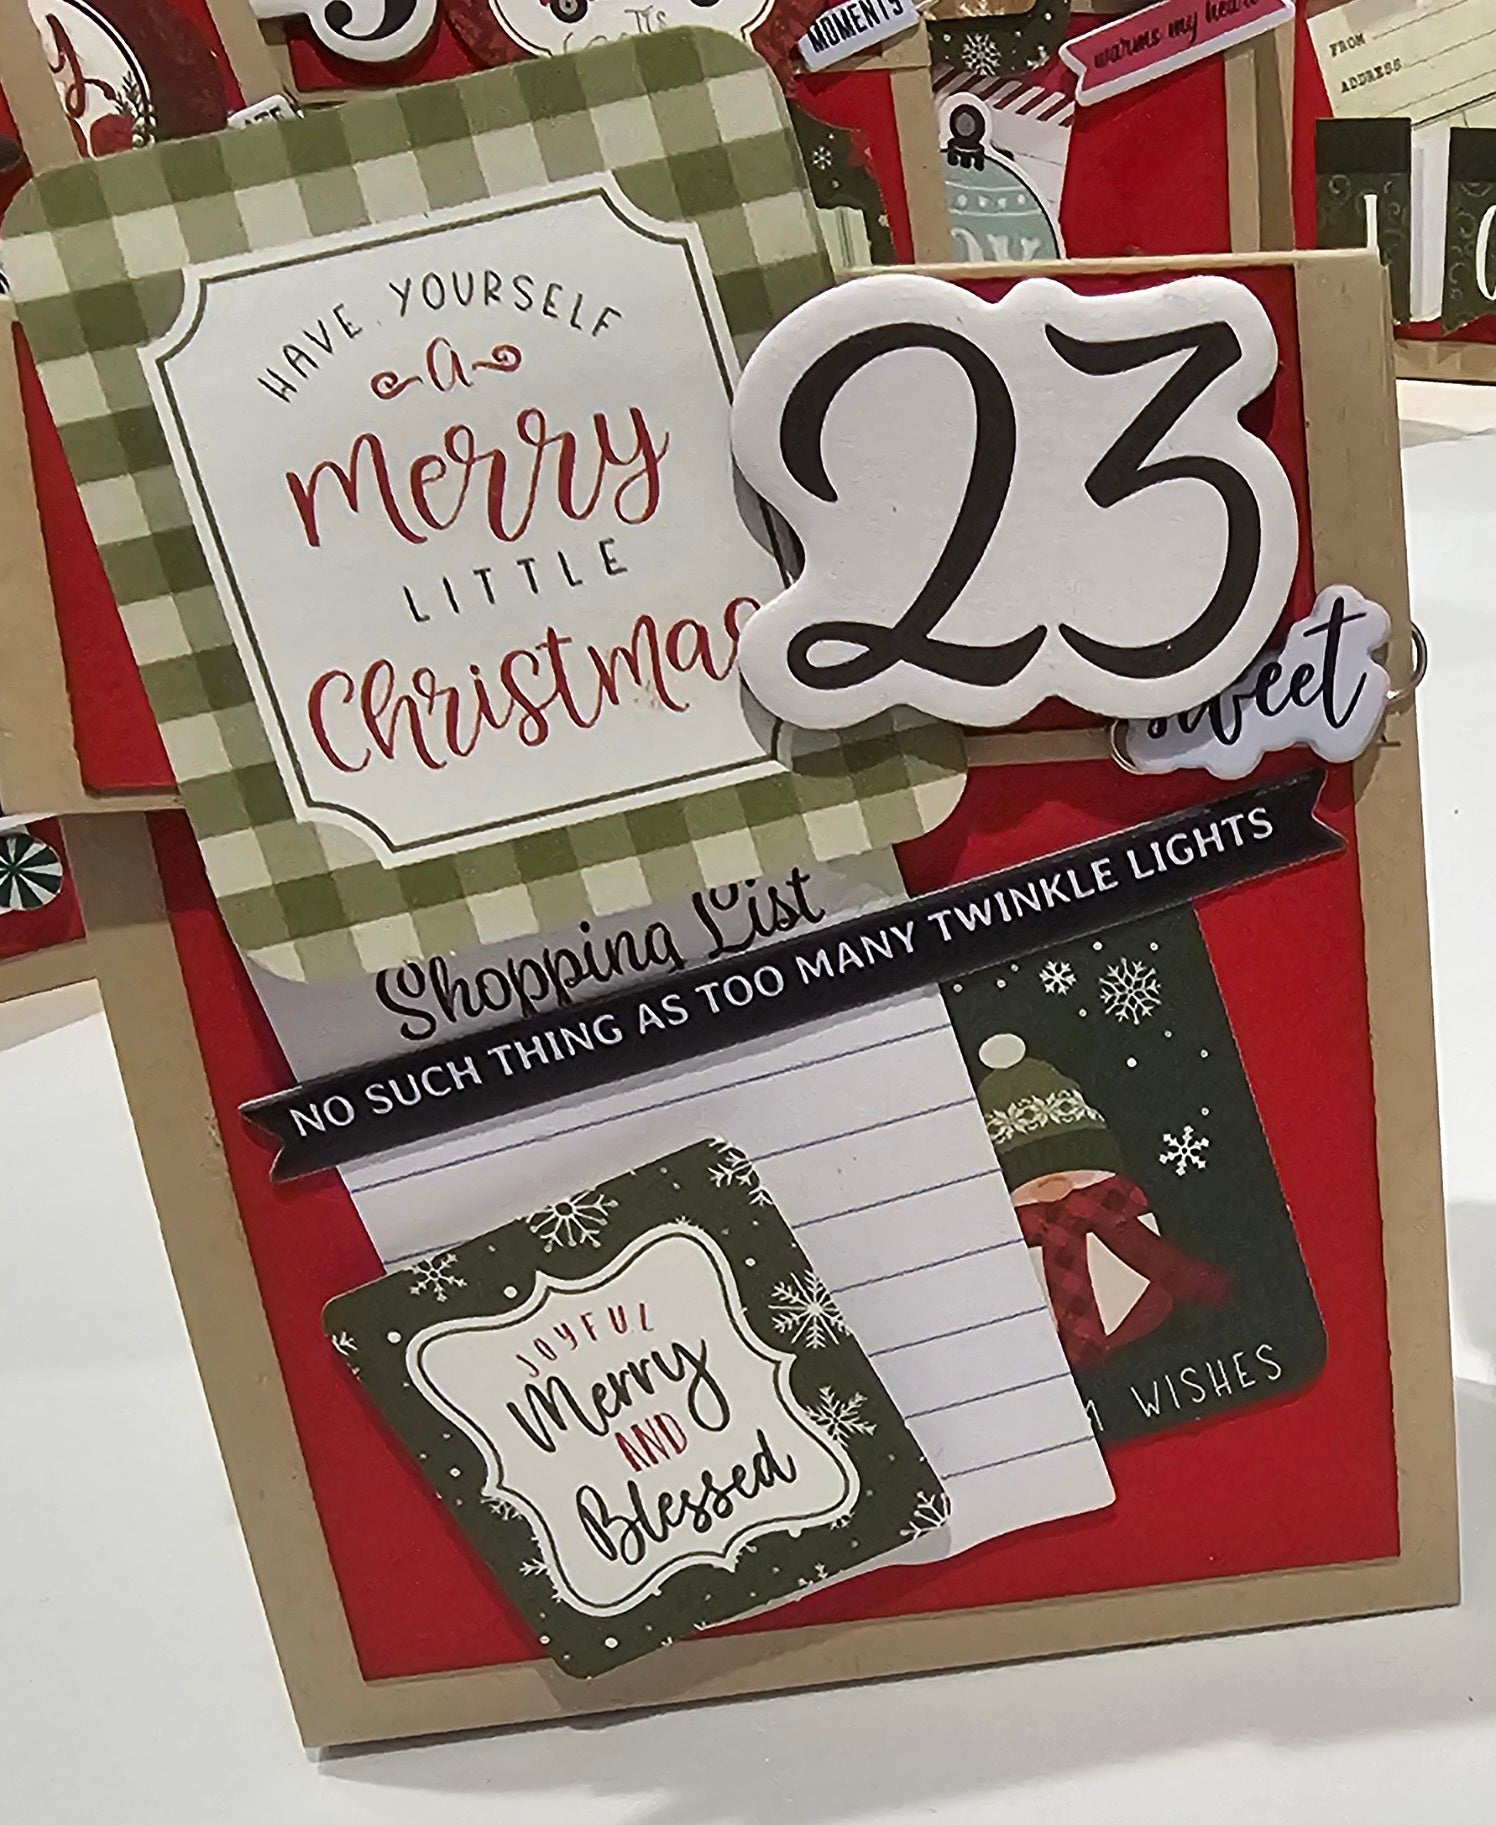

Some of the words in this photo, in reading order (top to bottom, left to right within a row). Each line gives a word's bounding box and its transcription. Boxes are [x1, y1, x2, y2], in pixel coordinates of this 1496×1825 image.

[1093, 29, 1160, 69] warms
[1167, 10, 1198, 46] my
[1329, 33, 1366, 58] FROM
[1341, 57, 1402, 94] ADDRESS
[257, 302, 364, 404] HAVE
[388, 269, 624, 338] YOURSELF
[426, 336, 473, 393] a
[285, 406, 671, 549] Merry
[779, 321, 1263, 690] 23
[402, 537, 629, 624] LITTLE
[288, 1094, 355, 1138] NO
[367, 1055, 483, 1115] SUCH
[487, 1014, 623, 1077] THING
[638, 993, 690, 1036] AS
[695, 965, 785, 1014] TOO
[795, 921, 915, 985] MANY
[928, 857, 1120, 942] TWINKLE
[1126, 805, 1274, 879] LIGHTS
[375, 920, 686, 1041] Shopping
[692, 866, 826, 960] List
[514, 1302, 655, 1378] JOYFUL
[1130, 1343, 1283, 1418] WISHES
[506, 1338, 731, 1454] Merry
[614, 1411, 688, 1473] AND
[575, 1429, 797, 1566] Blessed
